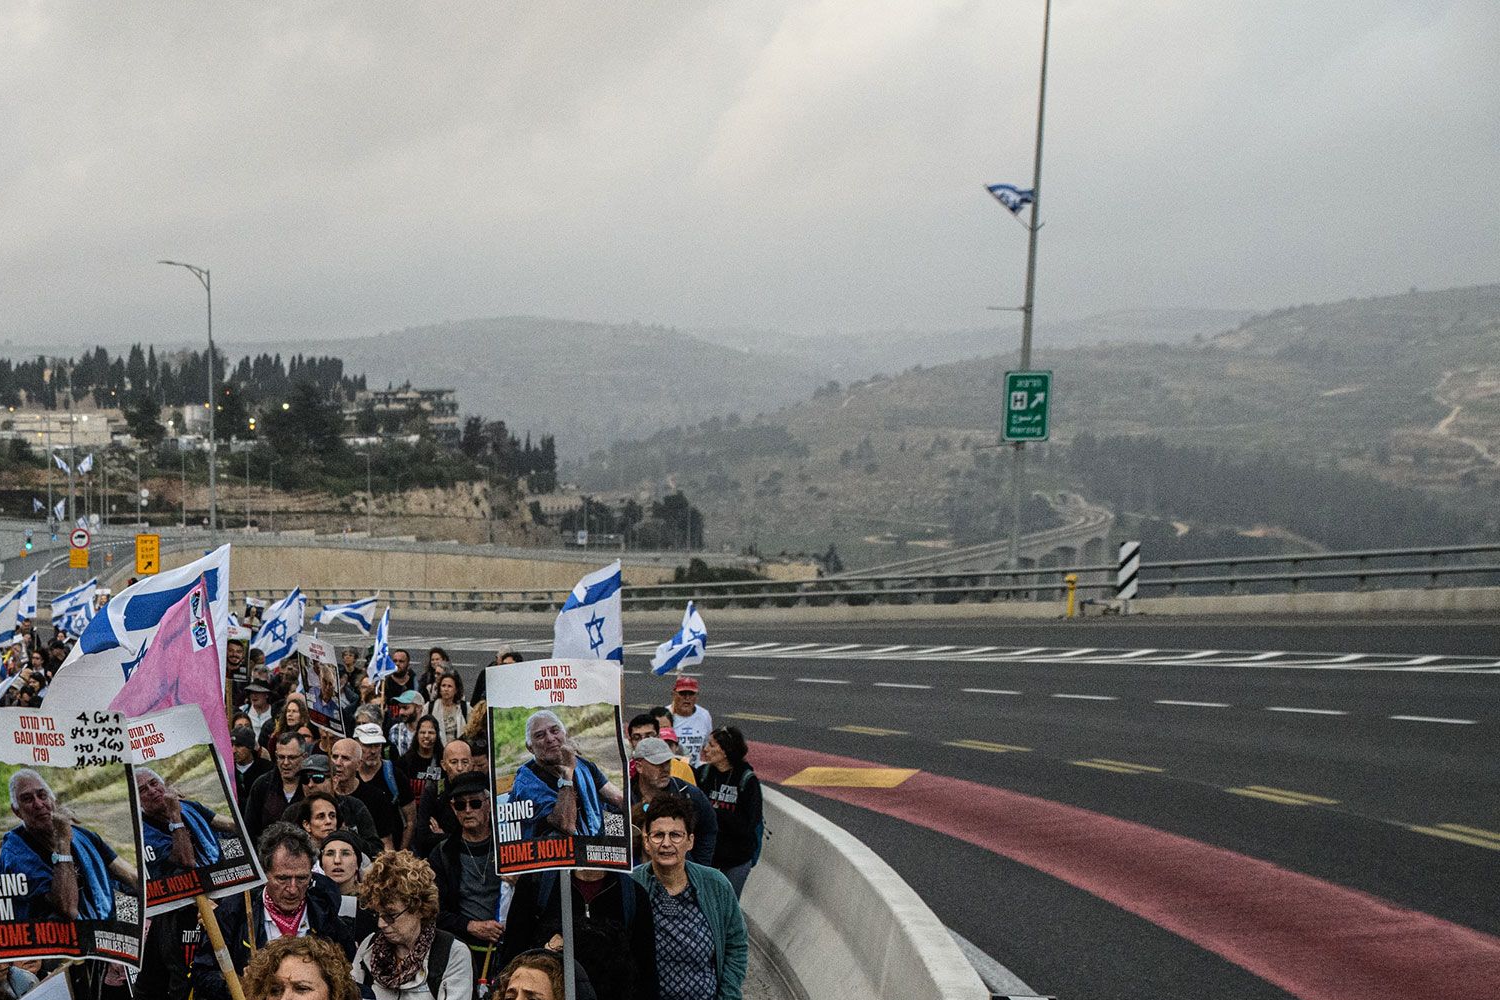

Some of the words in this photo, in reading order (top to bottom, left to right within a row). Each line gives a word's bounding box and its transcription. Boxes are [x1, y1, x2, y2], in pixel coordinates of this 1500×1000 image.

[540, 665, 559, 677] מוזס
[560, 665, 571, 677] גדי
[534, 679, 552, 690] GADI
[553, 678, 578, 690] MOSES
[550, 691, 565, 703] (79)
[19, 715, 40, 730] מוזס
[43, 717, 56, 731] גדי
[145, 723, 156, 736] גדי
[14, 730, 34, 745] GADI
[36, 732, 65, 747] MOSES
[128, 737, 147, 751] ADI
[147, 732, 165, 747] MOSES
[32, 747, 50, 763] (79)
[141, 747, 156, 761] (79)
[497, 799, 534, 822] BRING
[499, 821, 522, 843] HIM
[501, 842, 535, 864] HOME
[538, 836, 575, 861] NOW!
[587, 851, 609, 861] FAMILIES
[610, 852, 627, 862] FORUM
[147, 877, 168, 899] ME
[167, 870, 201, 893] NOW!
[34, 921, 78, 947] NOW!
[95, 937, 122, 953] FAMILIES
